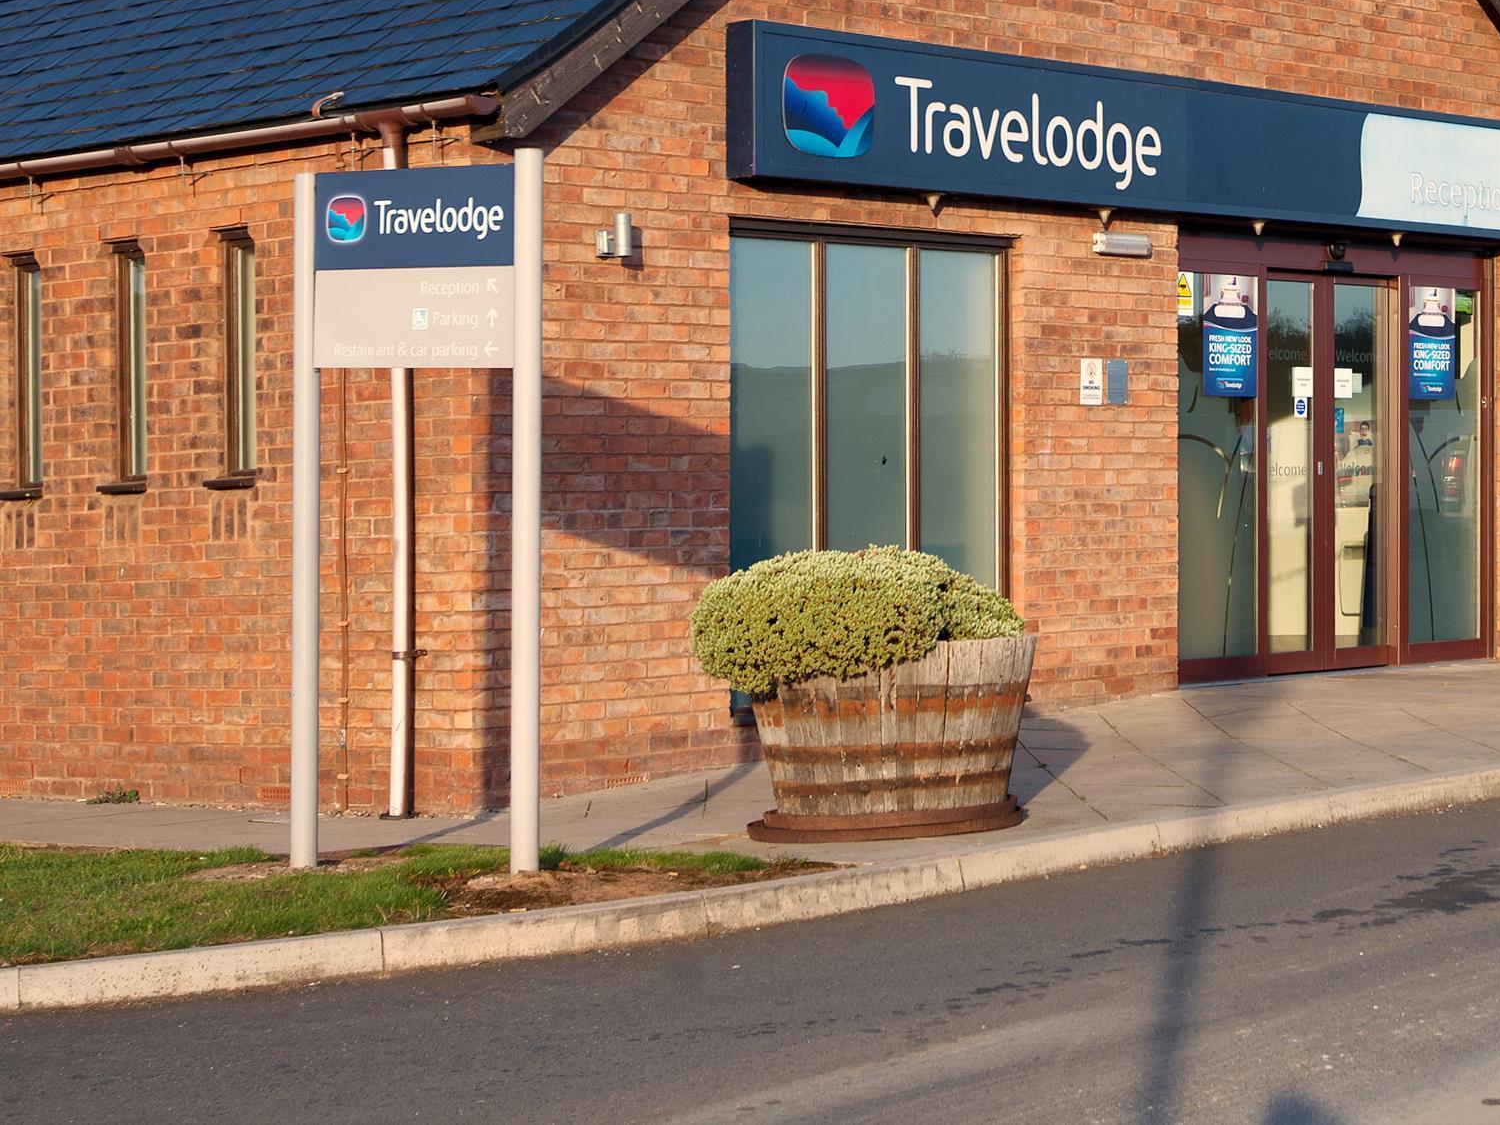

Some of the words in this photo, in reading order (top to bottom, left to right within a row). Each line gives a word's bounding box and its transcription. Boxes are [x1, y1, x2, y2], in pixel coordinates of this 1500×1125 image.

[894, 76, 1162, 190] Travelodge
[373, 197, 504, 240] Travelodge
[420, 280, 480, 298] Reception
[432, 310, 479, 329] Parking
[1209, 335, 1225, 343] FRESH
[1238, 336, 1252, 344] LOOK
[334, 342, 394, 357] Restaurant
[397, 342, 408, 357] &
[410, 344, 429, 357] car
[432, 341, 478, 360] parking
[1209, 343, 1252, 354] KING-SIZED
[1268, 348, 1307, 361] elcome
[1413, 349, 1451, 360] KING-SIZED
[1208, 353, 1252, 366] COMFORT
[1413, 359, 1451, 371] COMFORT
[1269, 462, 1308, 477] elcome
